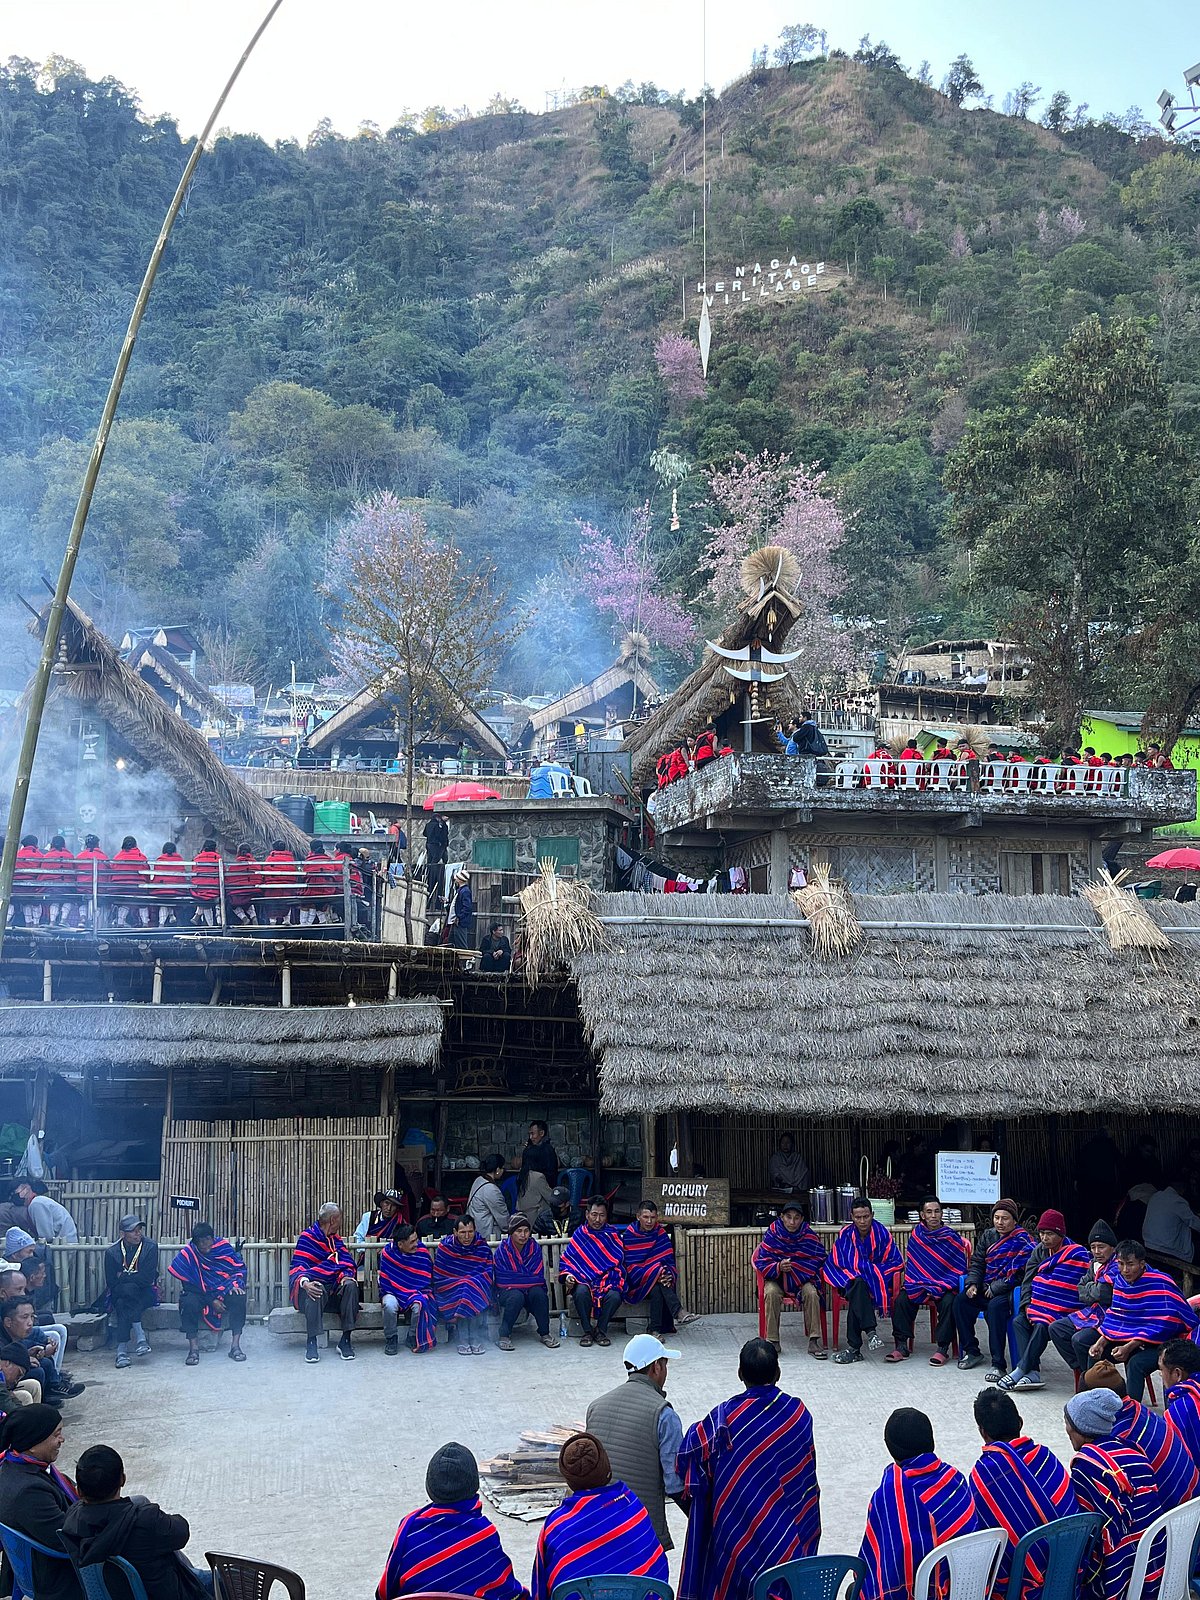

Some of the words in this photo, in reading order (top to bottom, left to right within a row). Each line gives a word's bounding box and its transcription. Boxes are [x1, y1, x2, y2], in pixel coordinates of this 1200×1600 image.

[697, 262, 825, 293] HERITAGE
[735, 255, 798, 278] NAGA
[705, 274, 817, 307] VILLAGE
[661, 1183, 709, 1197] POCHURY
[664, 1203, 707, 1217] MORUNG
